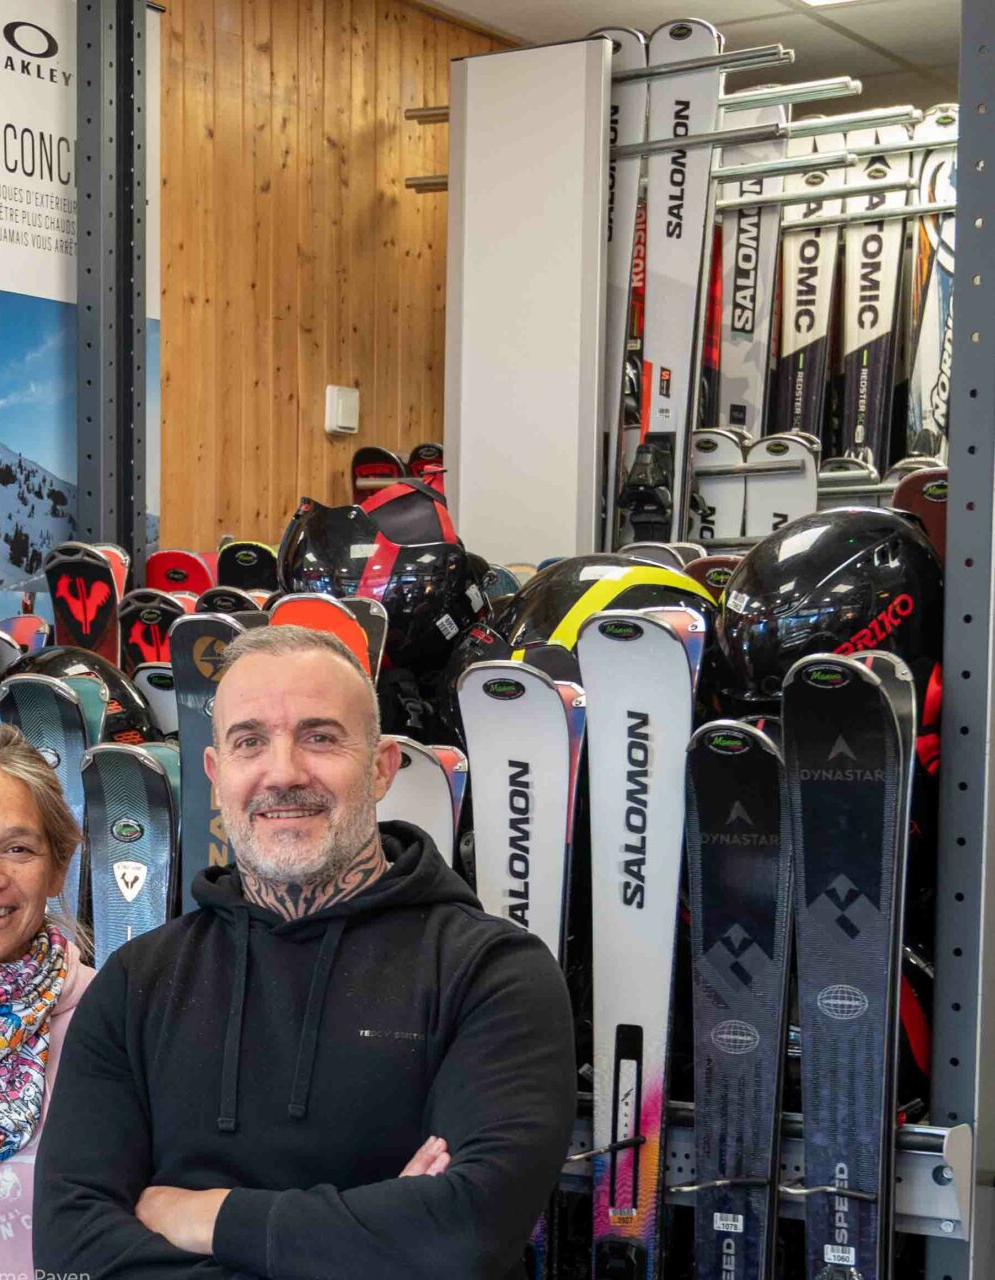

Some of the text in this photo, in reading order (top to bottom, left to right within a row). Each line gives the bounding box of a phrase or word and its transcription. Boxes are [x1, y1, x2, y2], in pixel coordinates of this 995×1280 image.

[3, 123, 78, 187] CONC
[666, 100, 691, 239] SALOMON
[21, 208, 44, 229] PLUS
[31, 233, 54, 253] VOUS
[733, 180, 763, 333] SALOMN
[799, 768, 884, 783] DYNASTAR
[623, 710, 650, 911] SALOMON
[700, 832, 780, 847] DYNASTAR
[507, 759, 531, 931] ALOMON
[835, 1161, 849, 1244] SPEED
[832, 1253, 850, 1263] 1060
